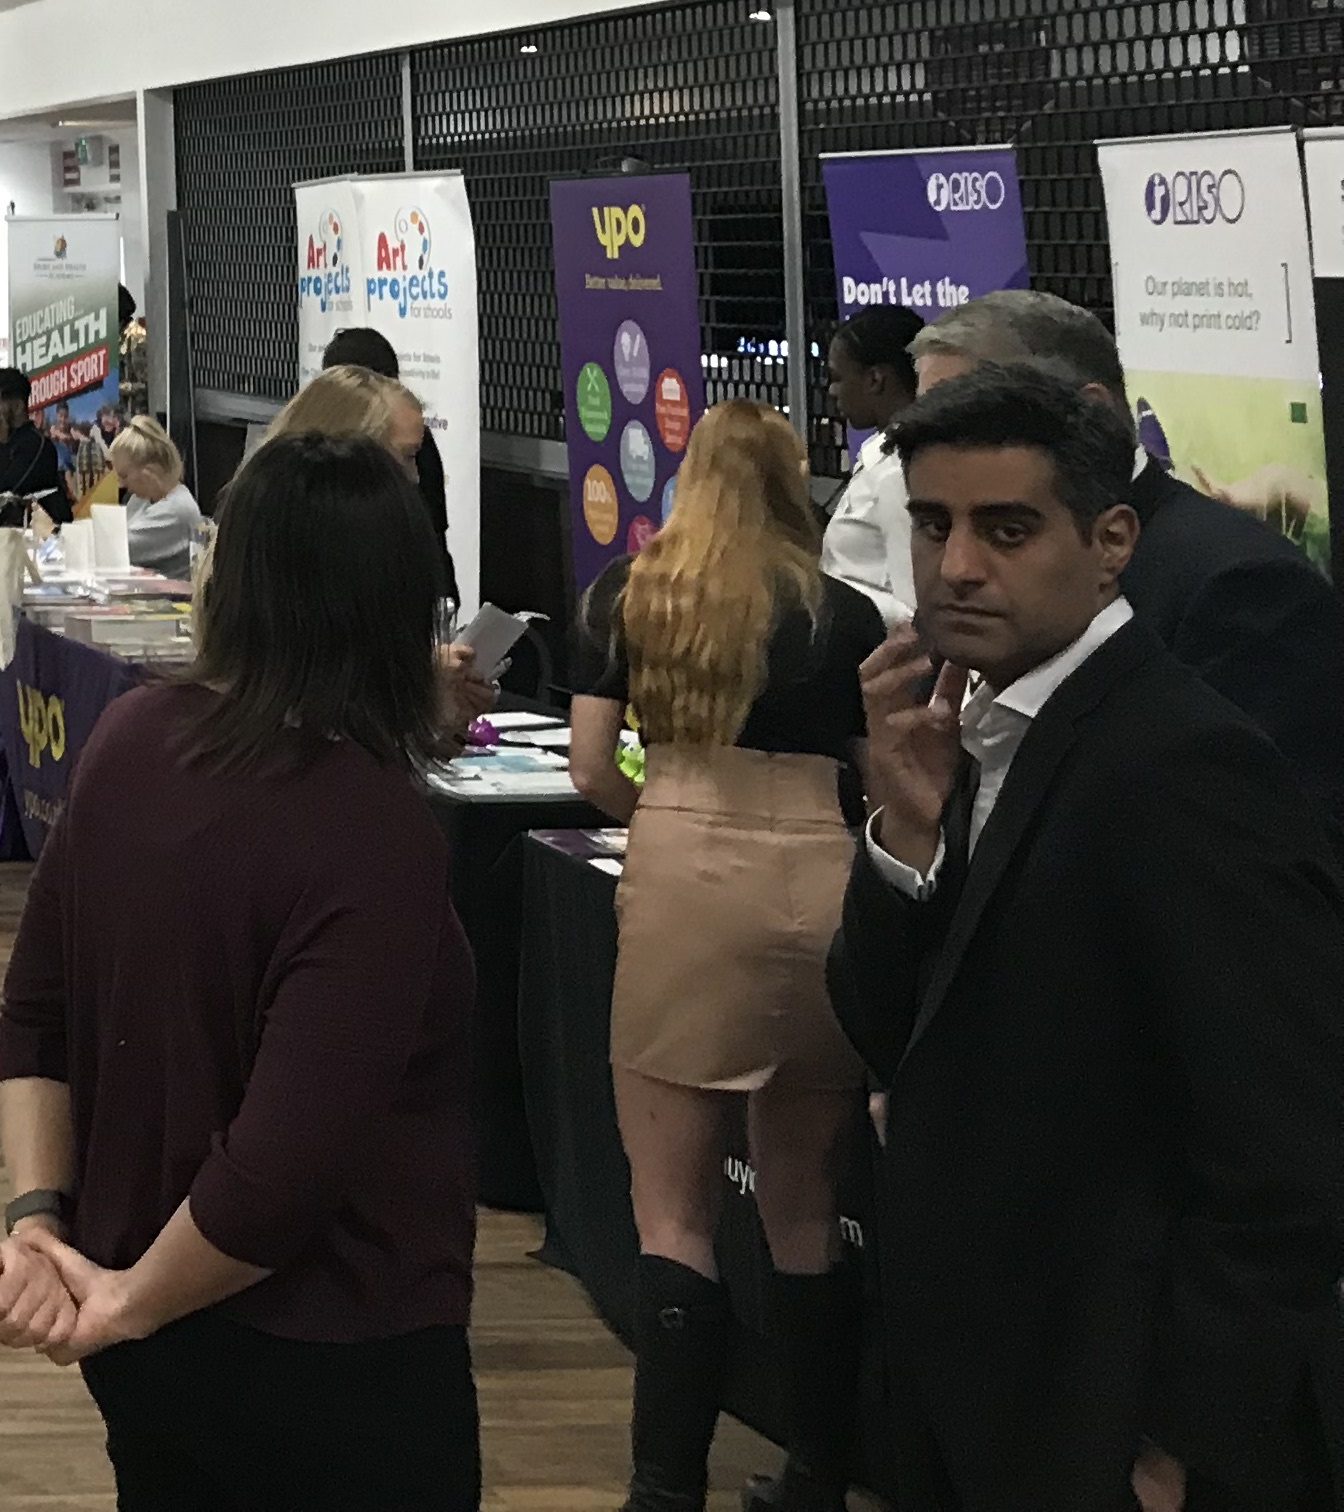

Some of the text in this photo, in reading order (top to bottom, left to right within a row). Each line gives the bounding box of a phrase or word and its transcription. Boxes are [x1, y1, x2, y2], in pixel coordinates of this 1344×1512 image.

[949, 171, 1005, 211] RISO
[1173, 169, 1245, 225] RISO
[307, 233, 328, 270] Art
[376, 231, 408, 272] Art
[592, 204, 646, 259] ypo
[299, 264, 351, 313] projects
[366, 267, 449, 319] projects
[900, 276, 933, 307] Let
[936, 275, 970, 307] the
[1144, 274, 1168, 298] Our
[1171, 276, 1210, 299] planet
[1213, 277, 1224, 298] is
[15, 307, 108, 373] HEALTH
[1139, 307, 1262, 333] why not print cold?
[28, 349, 107, 409] ROUGH SPORT
[17, 678, 66, 769] ypo
